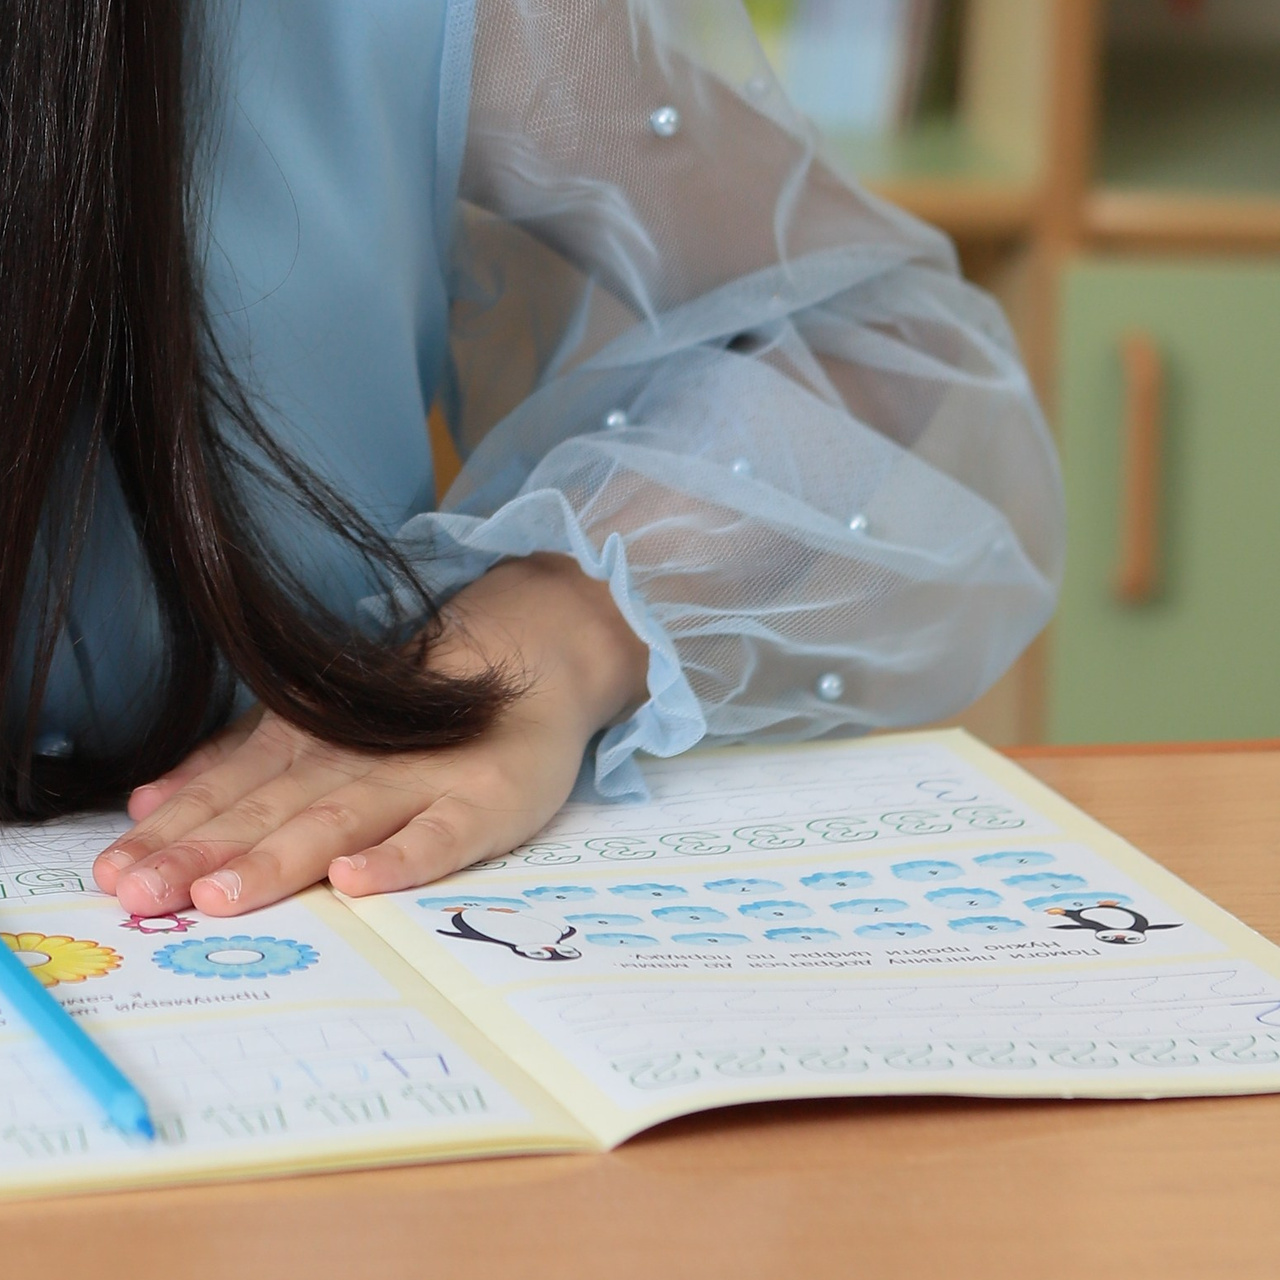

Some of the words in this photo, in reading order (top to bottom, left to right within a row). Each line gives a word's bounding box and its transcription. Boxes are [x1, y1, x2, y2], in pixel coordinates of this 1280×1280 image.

[16, 869, 84, 896] 5
[984, 940, 1062, 952] Нужно
[629, 953, 732, 962] порядку.
[746, 953, 776, 961] по
[789, 951, 872, 961] цифры
[885, 946, 971, 958] пройти
[1009, 948, 1101, 960] Помоги
[748, 959, 872, 970] добраться
[888, 954, 997, 965] пингвину
[703, 961, 733, 970] до
[114, 990, 271, 1014] Пронумеруй
